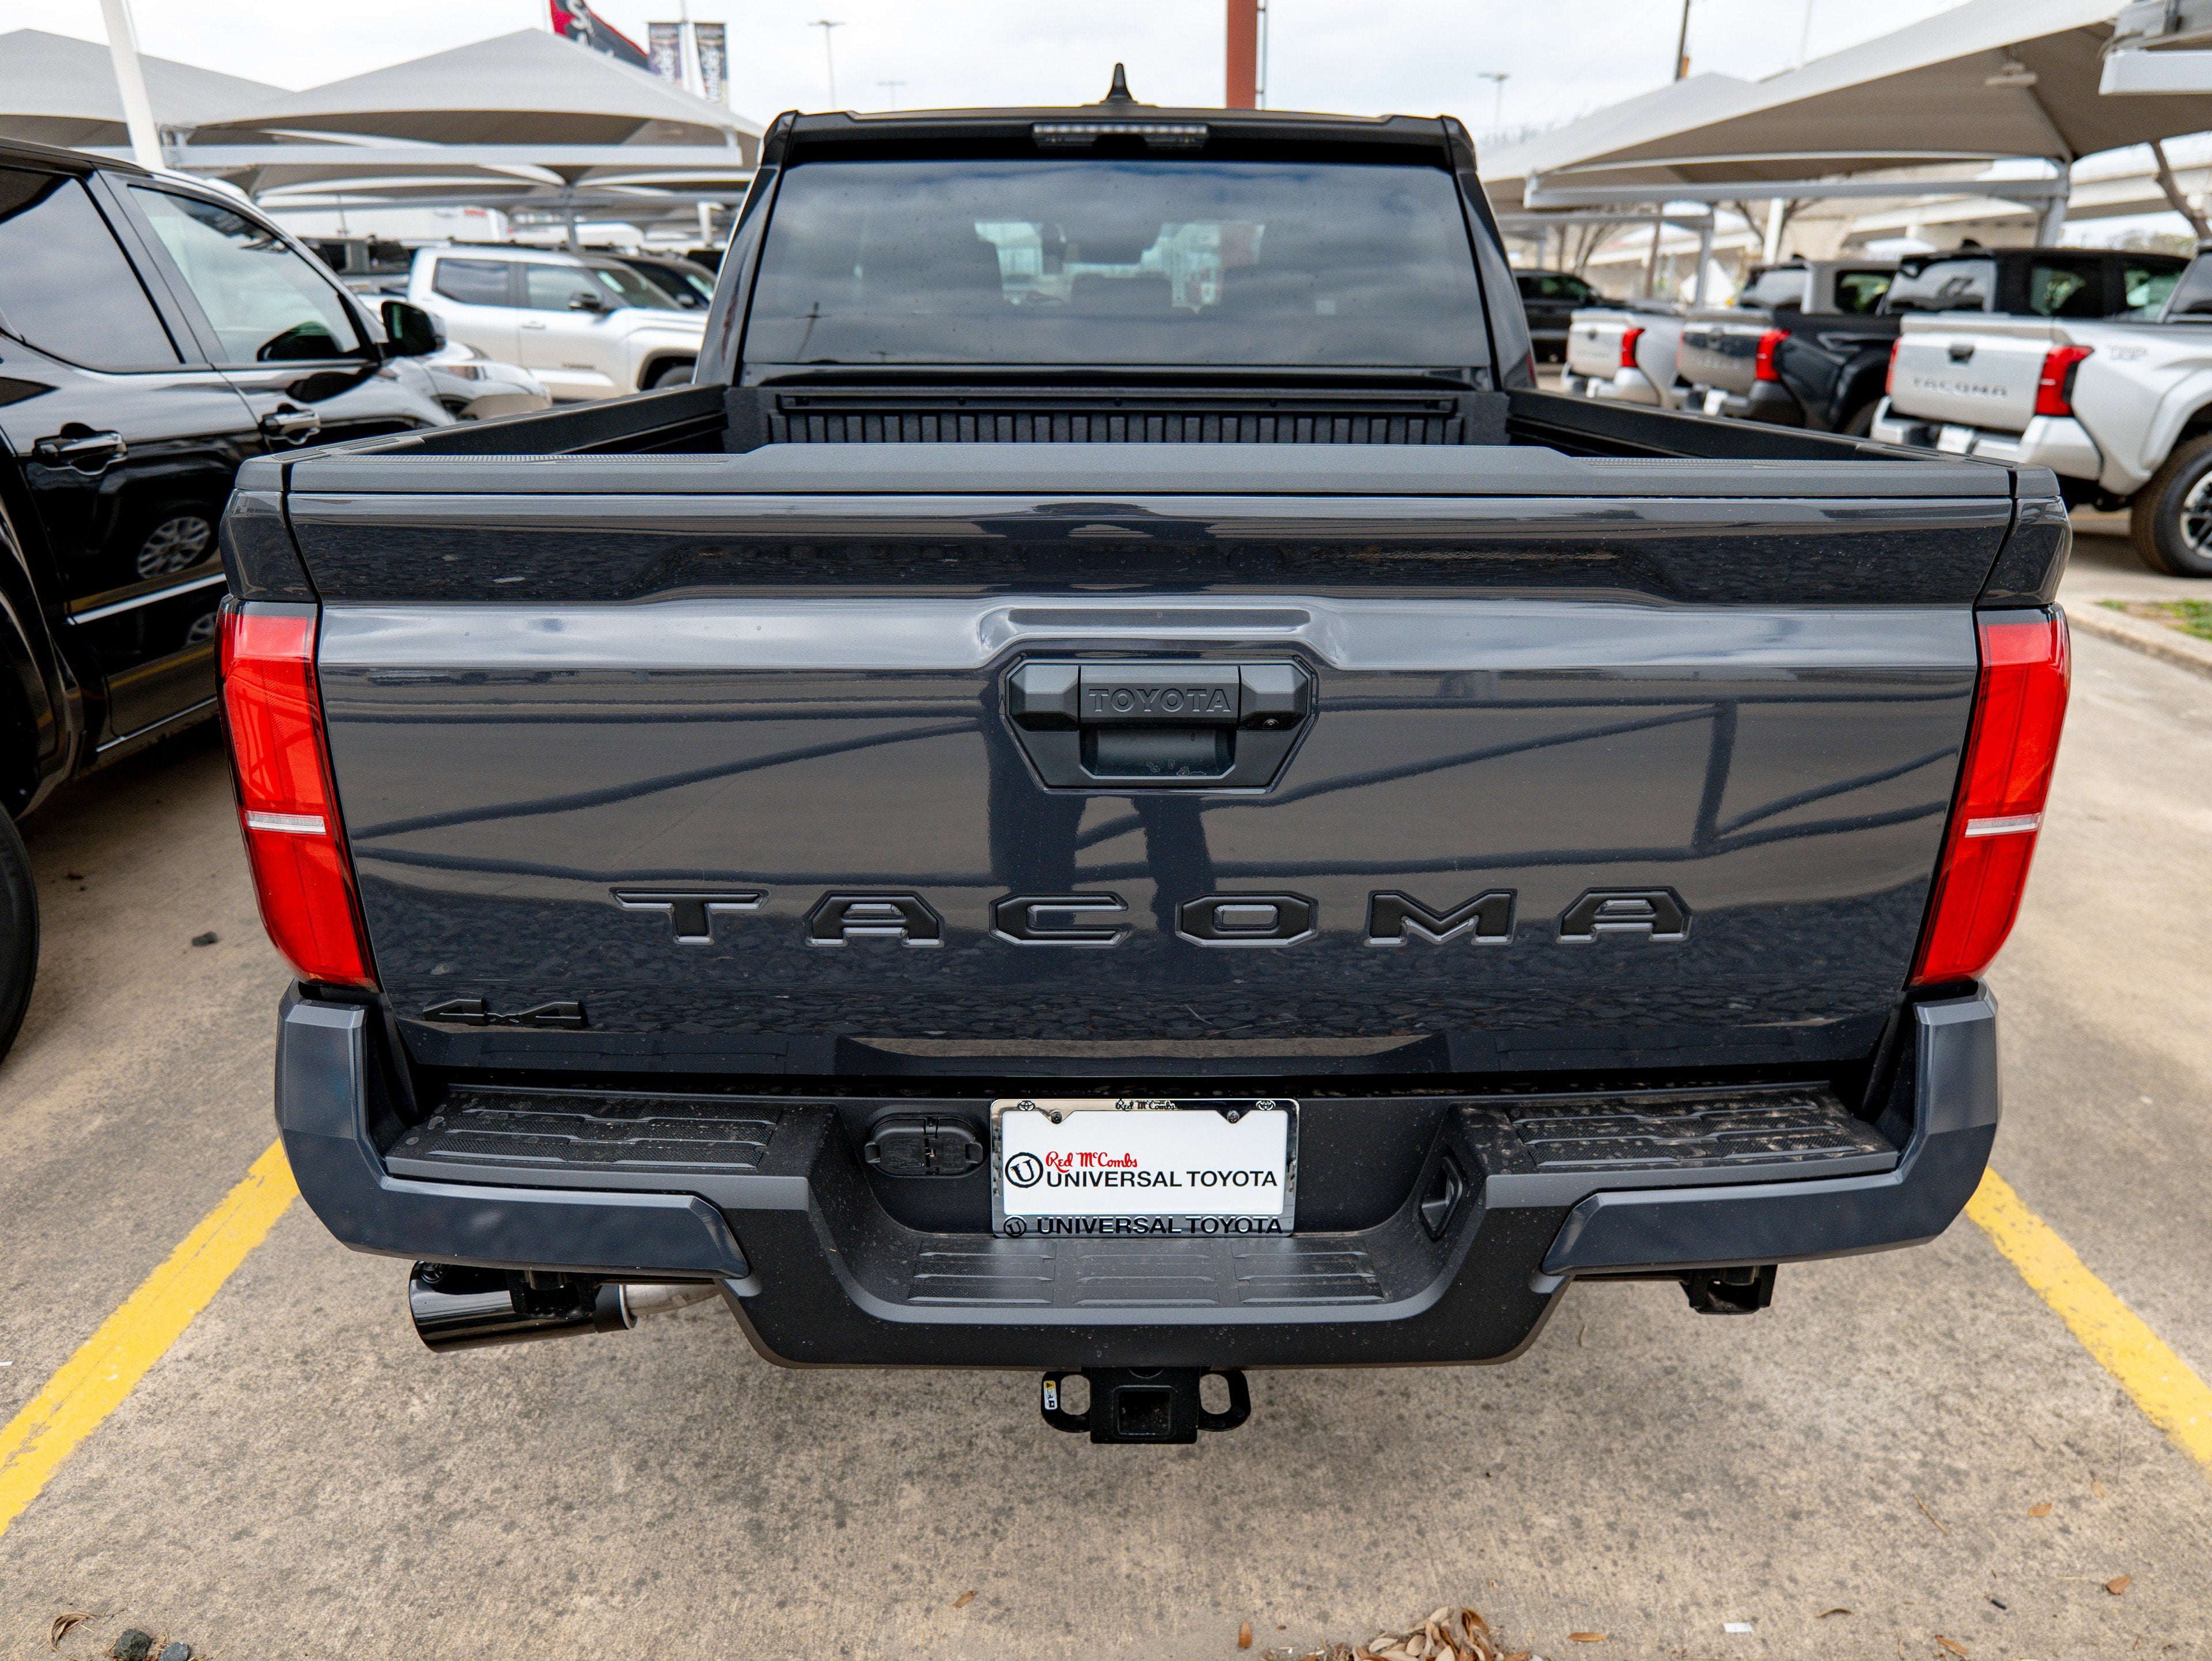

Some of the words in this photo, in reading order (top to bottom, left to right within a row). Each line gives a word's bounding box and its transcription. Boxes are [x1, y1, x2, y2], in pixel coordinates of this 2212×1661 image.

[1089, 688, 1232, 713] TOYOTA
[609, 886, 1691, 948] TACOMA
[1115, 1098, 1134, 1111] Red
[1046, 1151, 1073, 1173] Red
[1075, 1152, 1138, 1168] McCombs
[1047, 1171, 1182, 1187] UNIVERSAL
[1186, 1171, 1278, 1187] TOYOTA
[1037, 1216, 1182, 1234] UNIVERSAL
[1185, 1216, 1283, 1234] TOYOTA
